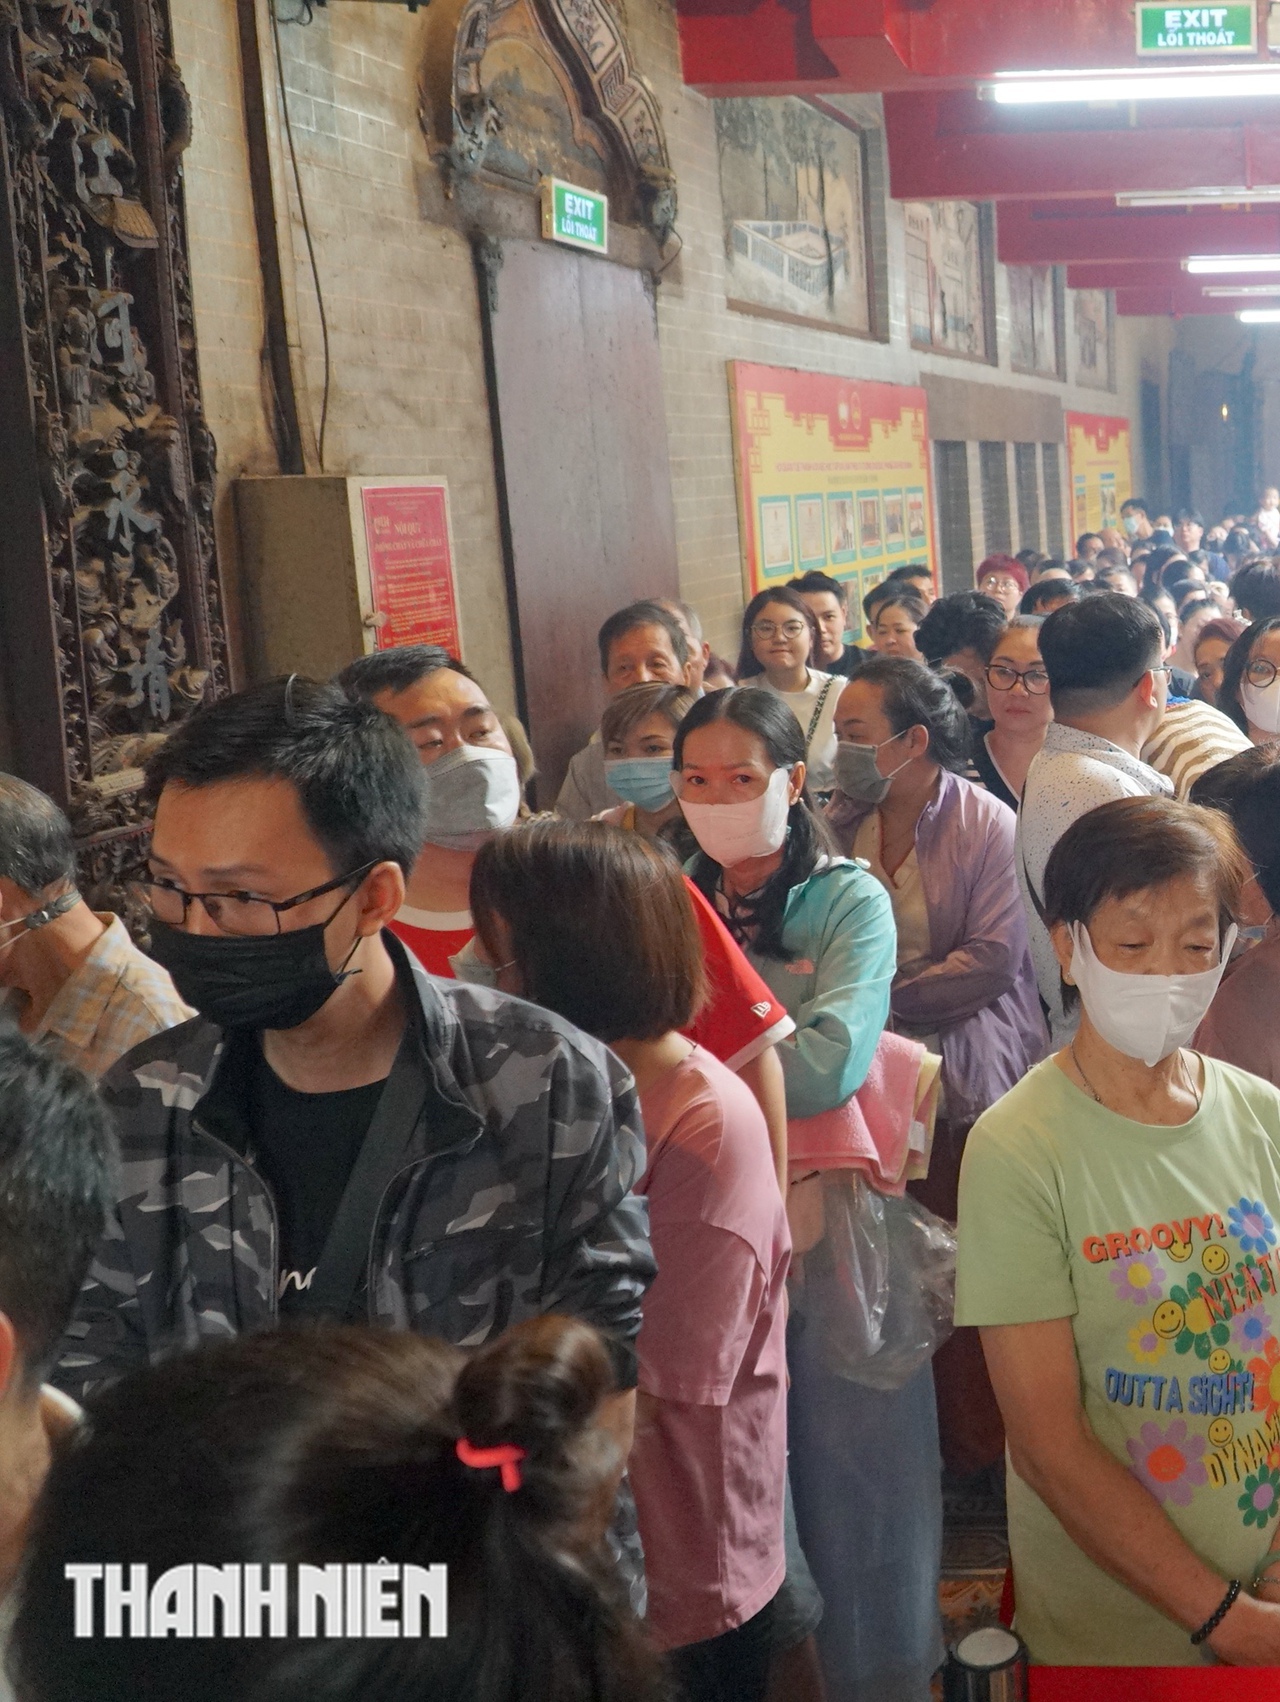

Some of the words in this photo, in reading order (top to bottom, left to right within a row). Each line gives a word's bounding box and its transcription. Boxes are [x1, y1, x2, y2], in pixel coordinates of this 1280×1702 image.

[1164, 8, 1228, 28] EXIT
[1186, 28, 1235, 46] THOÁT
[565, 192, 595, 221] EXIT
[575, 221, 598, 242] THOÁT
[1081, 1213, 1227, 1264] GROOVY!
[1105, 1367, 1183, 1413] OUTTA
